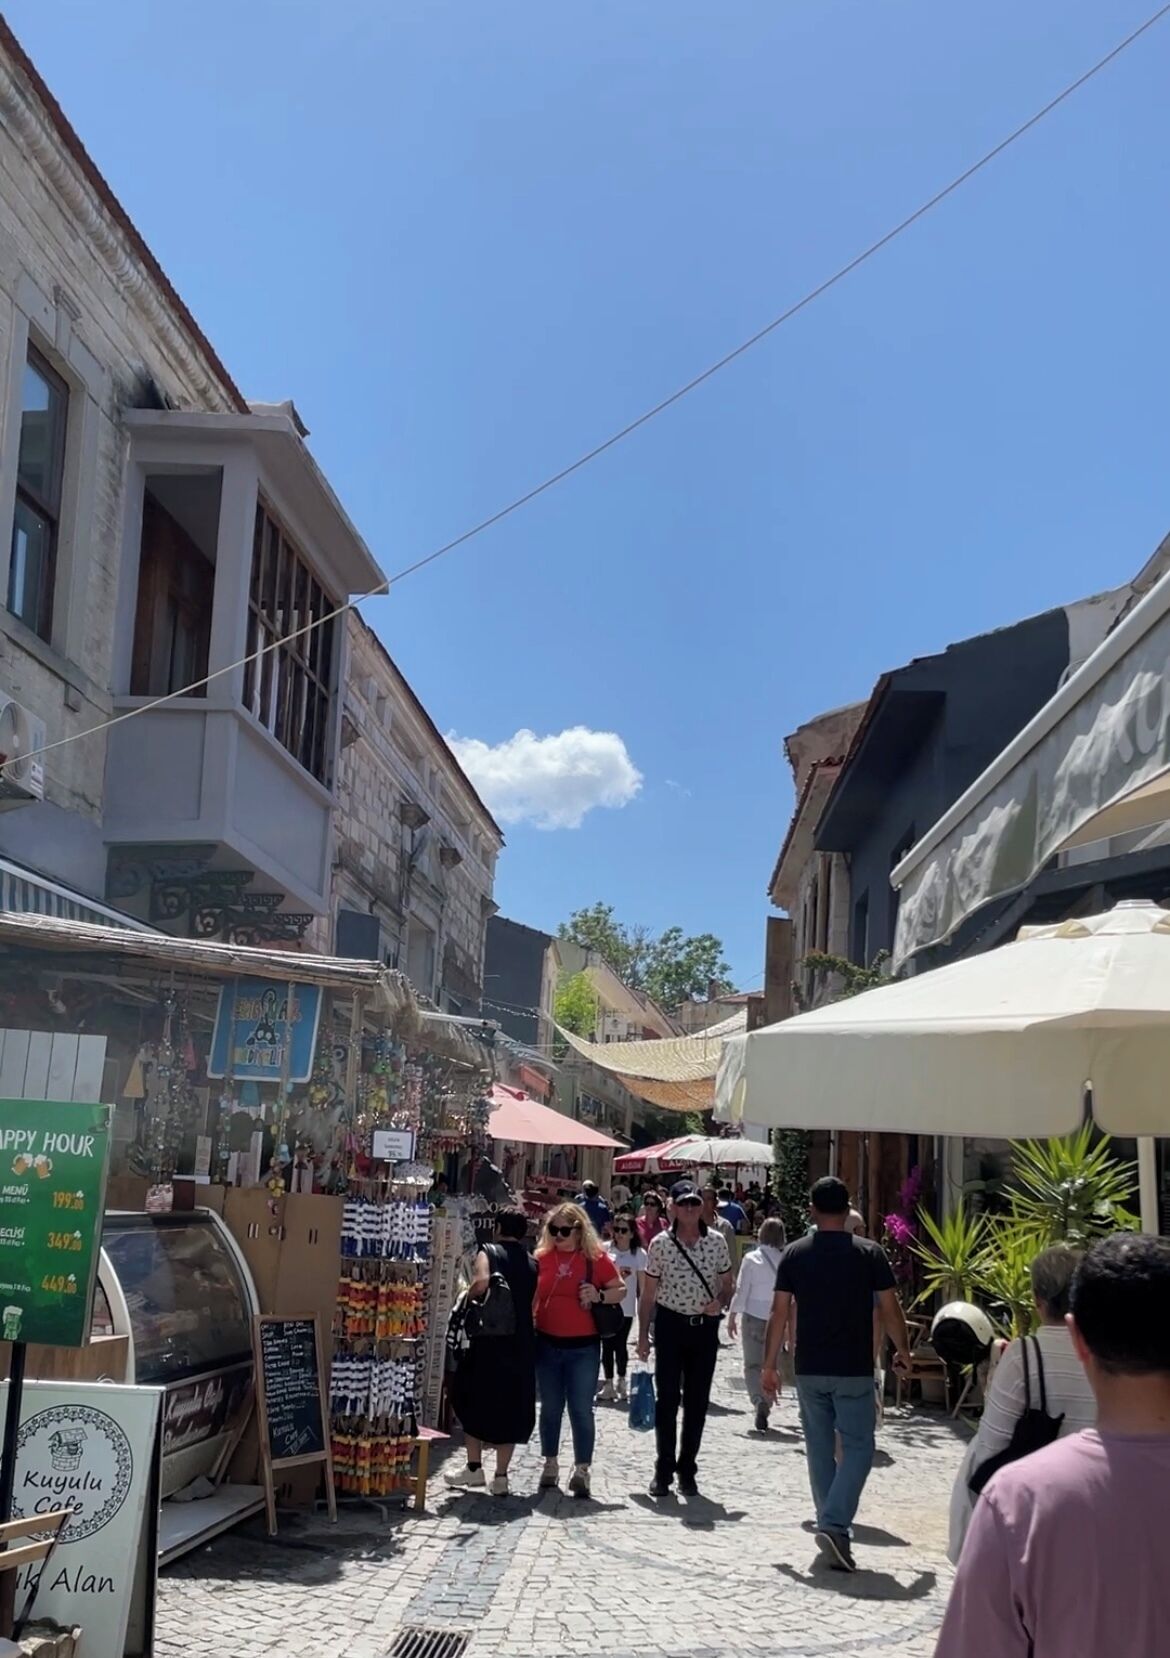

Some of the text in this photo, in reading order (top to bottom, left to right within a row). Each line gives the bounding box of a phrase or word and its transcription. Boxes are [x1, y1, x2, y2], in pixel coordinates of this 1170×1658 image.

[0, 1129, 94, 1157] PPY HOUR
[2, 1184, 28, 1196] MENÜ
[23, 1470, 103, 1495] Kuyulu
[34, 1495, 84, 1515] Cafe
[50, 1565, 115, 1593] Alan
